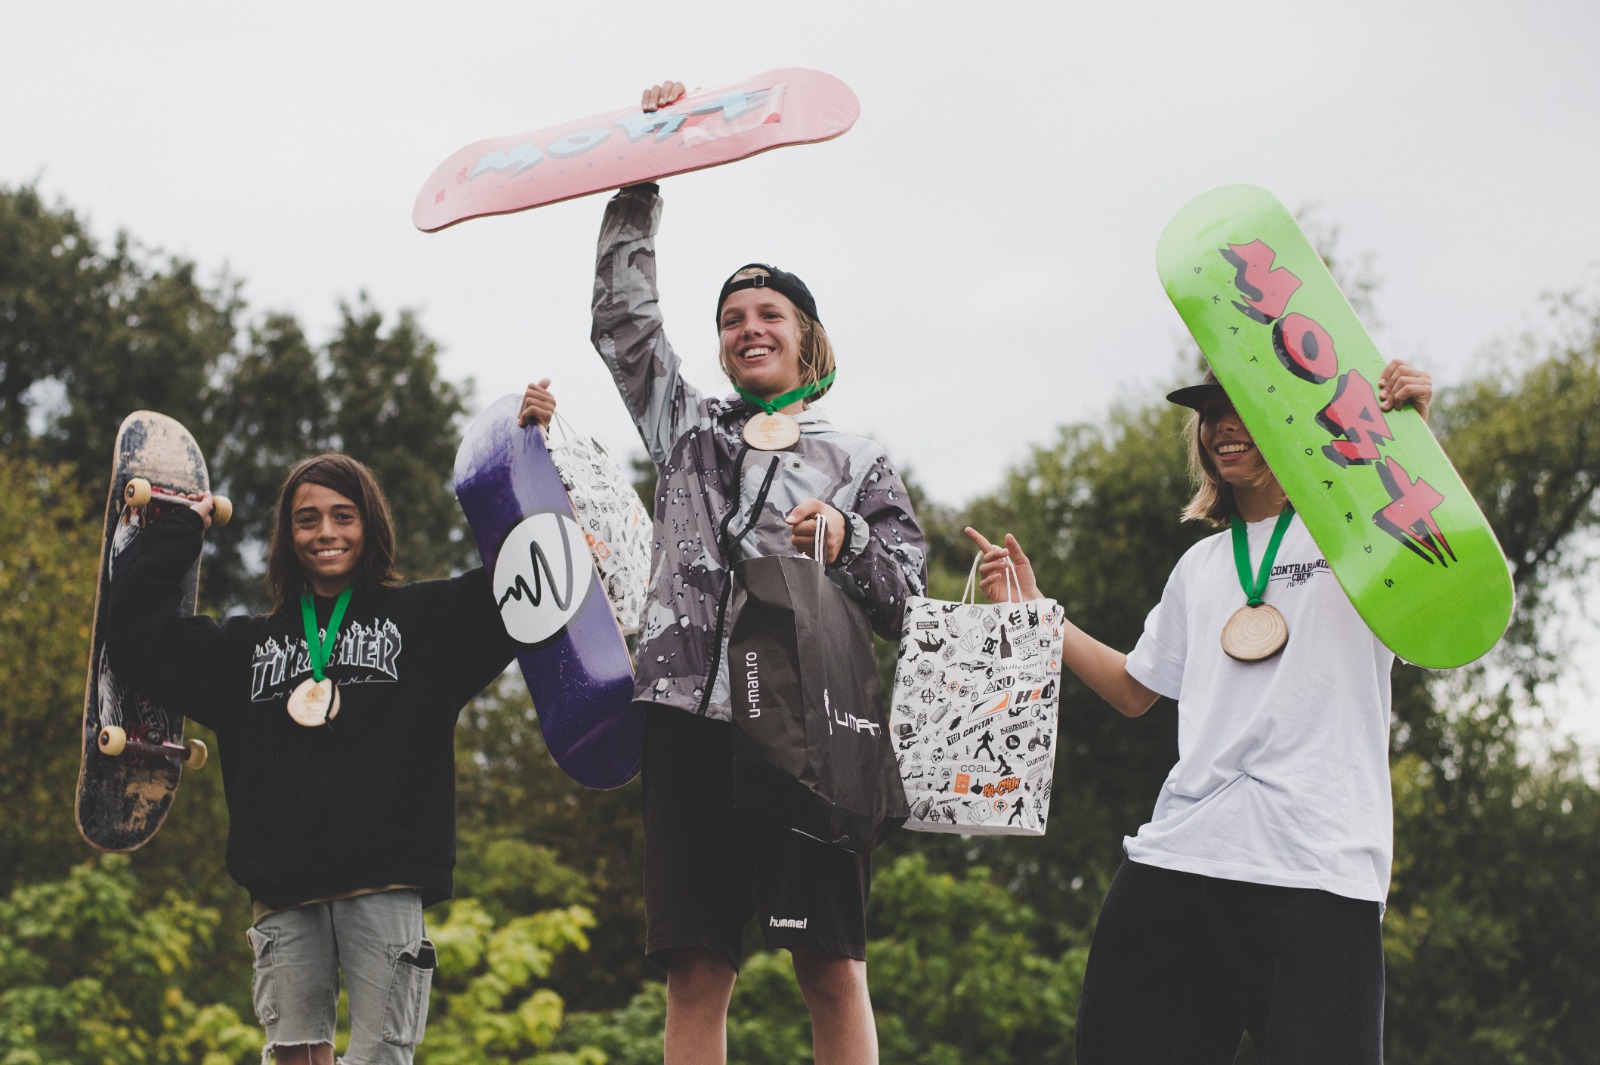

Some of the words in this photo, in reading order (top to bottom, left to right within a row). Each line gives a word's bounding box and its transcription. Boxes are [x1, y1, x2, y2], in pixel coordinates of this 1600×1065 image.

[1194, 265, 1394, 589] SKATEBOARDS
[745, 651, 761, 719] u-man.ro
[769, 915, 808, 930] hummel
